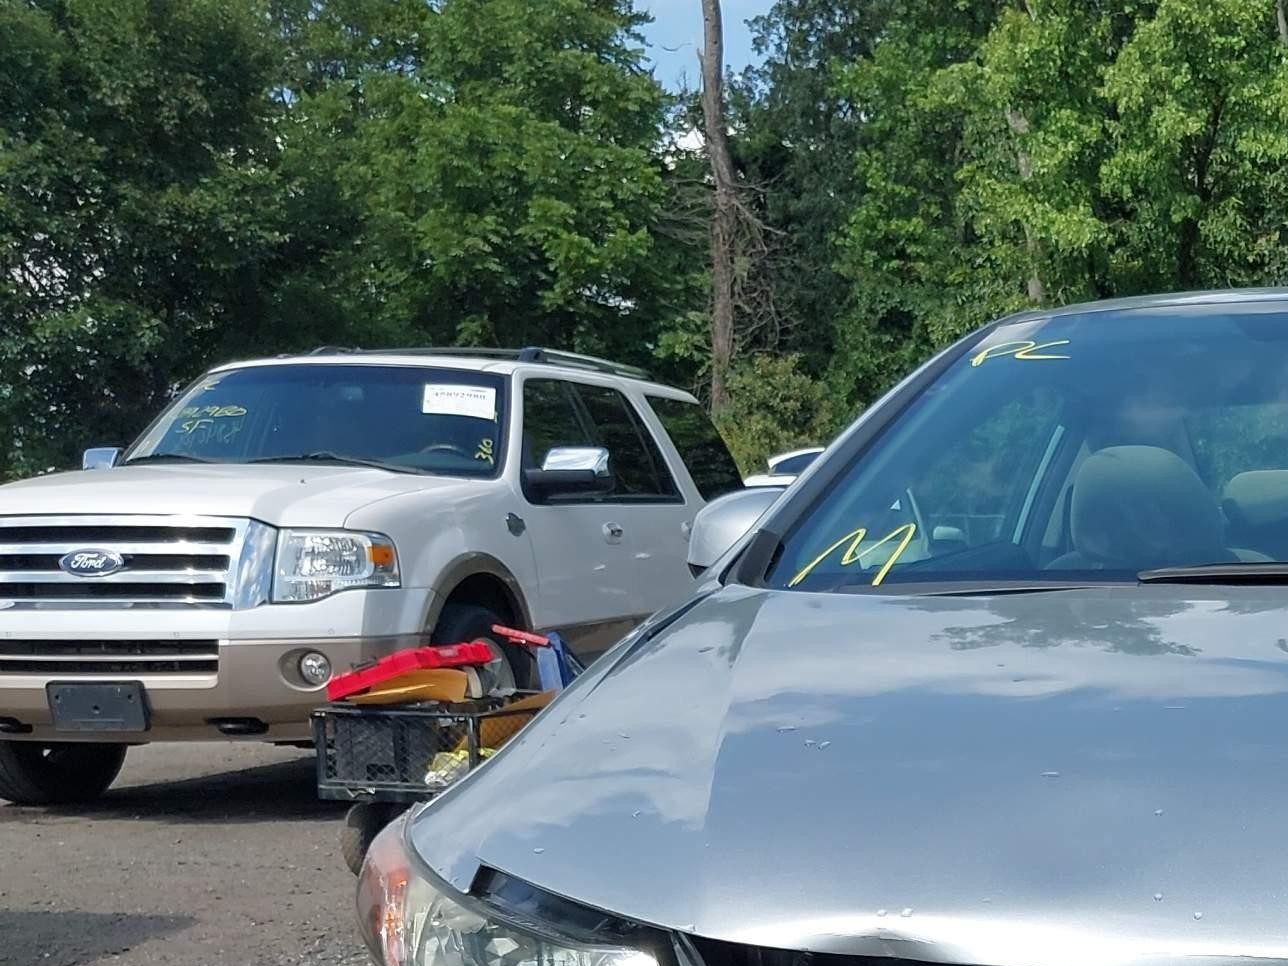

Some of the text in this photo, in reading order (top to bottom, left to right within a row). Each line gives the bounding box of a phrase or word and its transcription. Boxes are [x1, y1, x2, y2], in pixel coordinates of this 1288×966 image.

[970, 337, 1071, 367] PC
[70, 553, 107, 569] Ford
[787, 522, 916, 587] M
